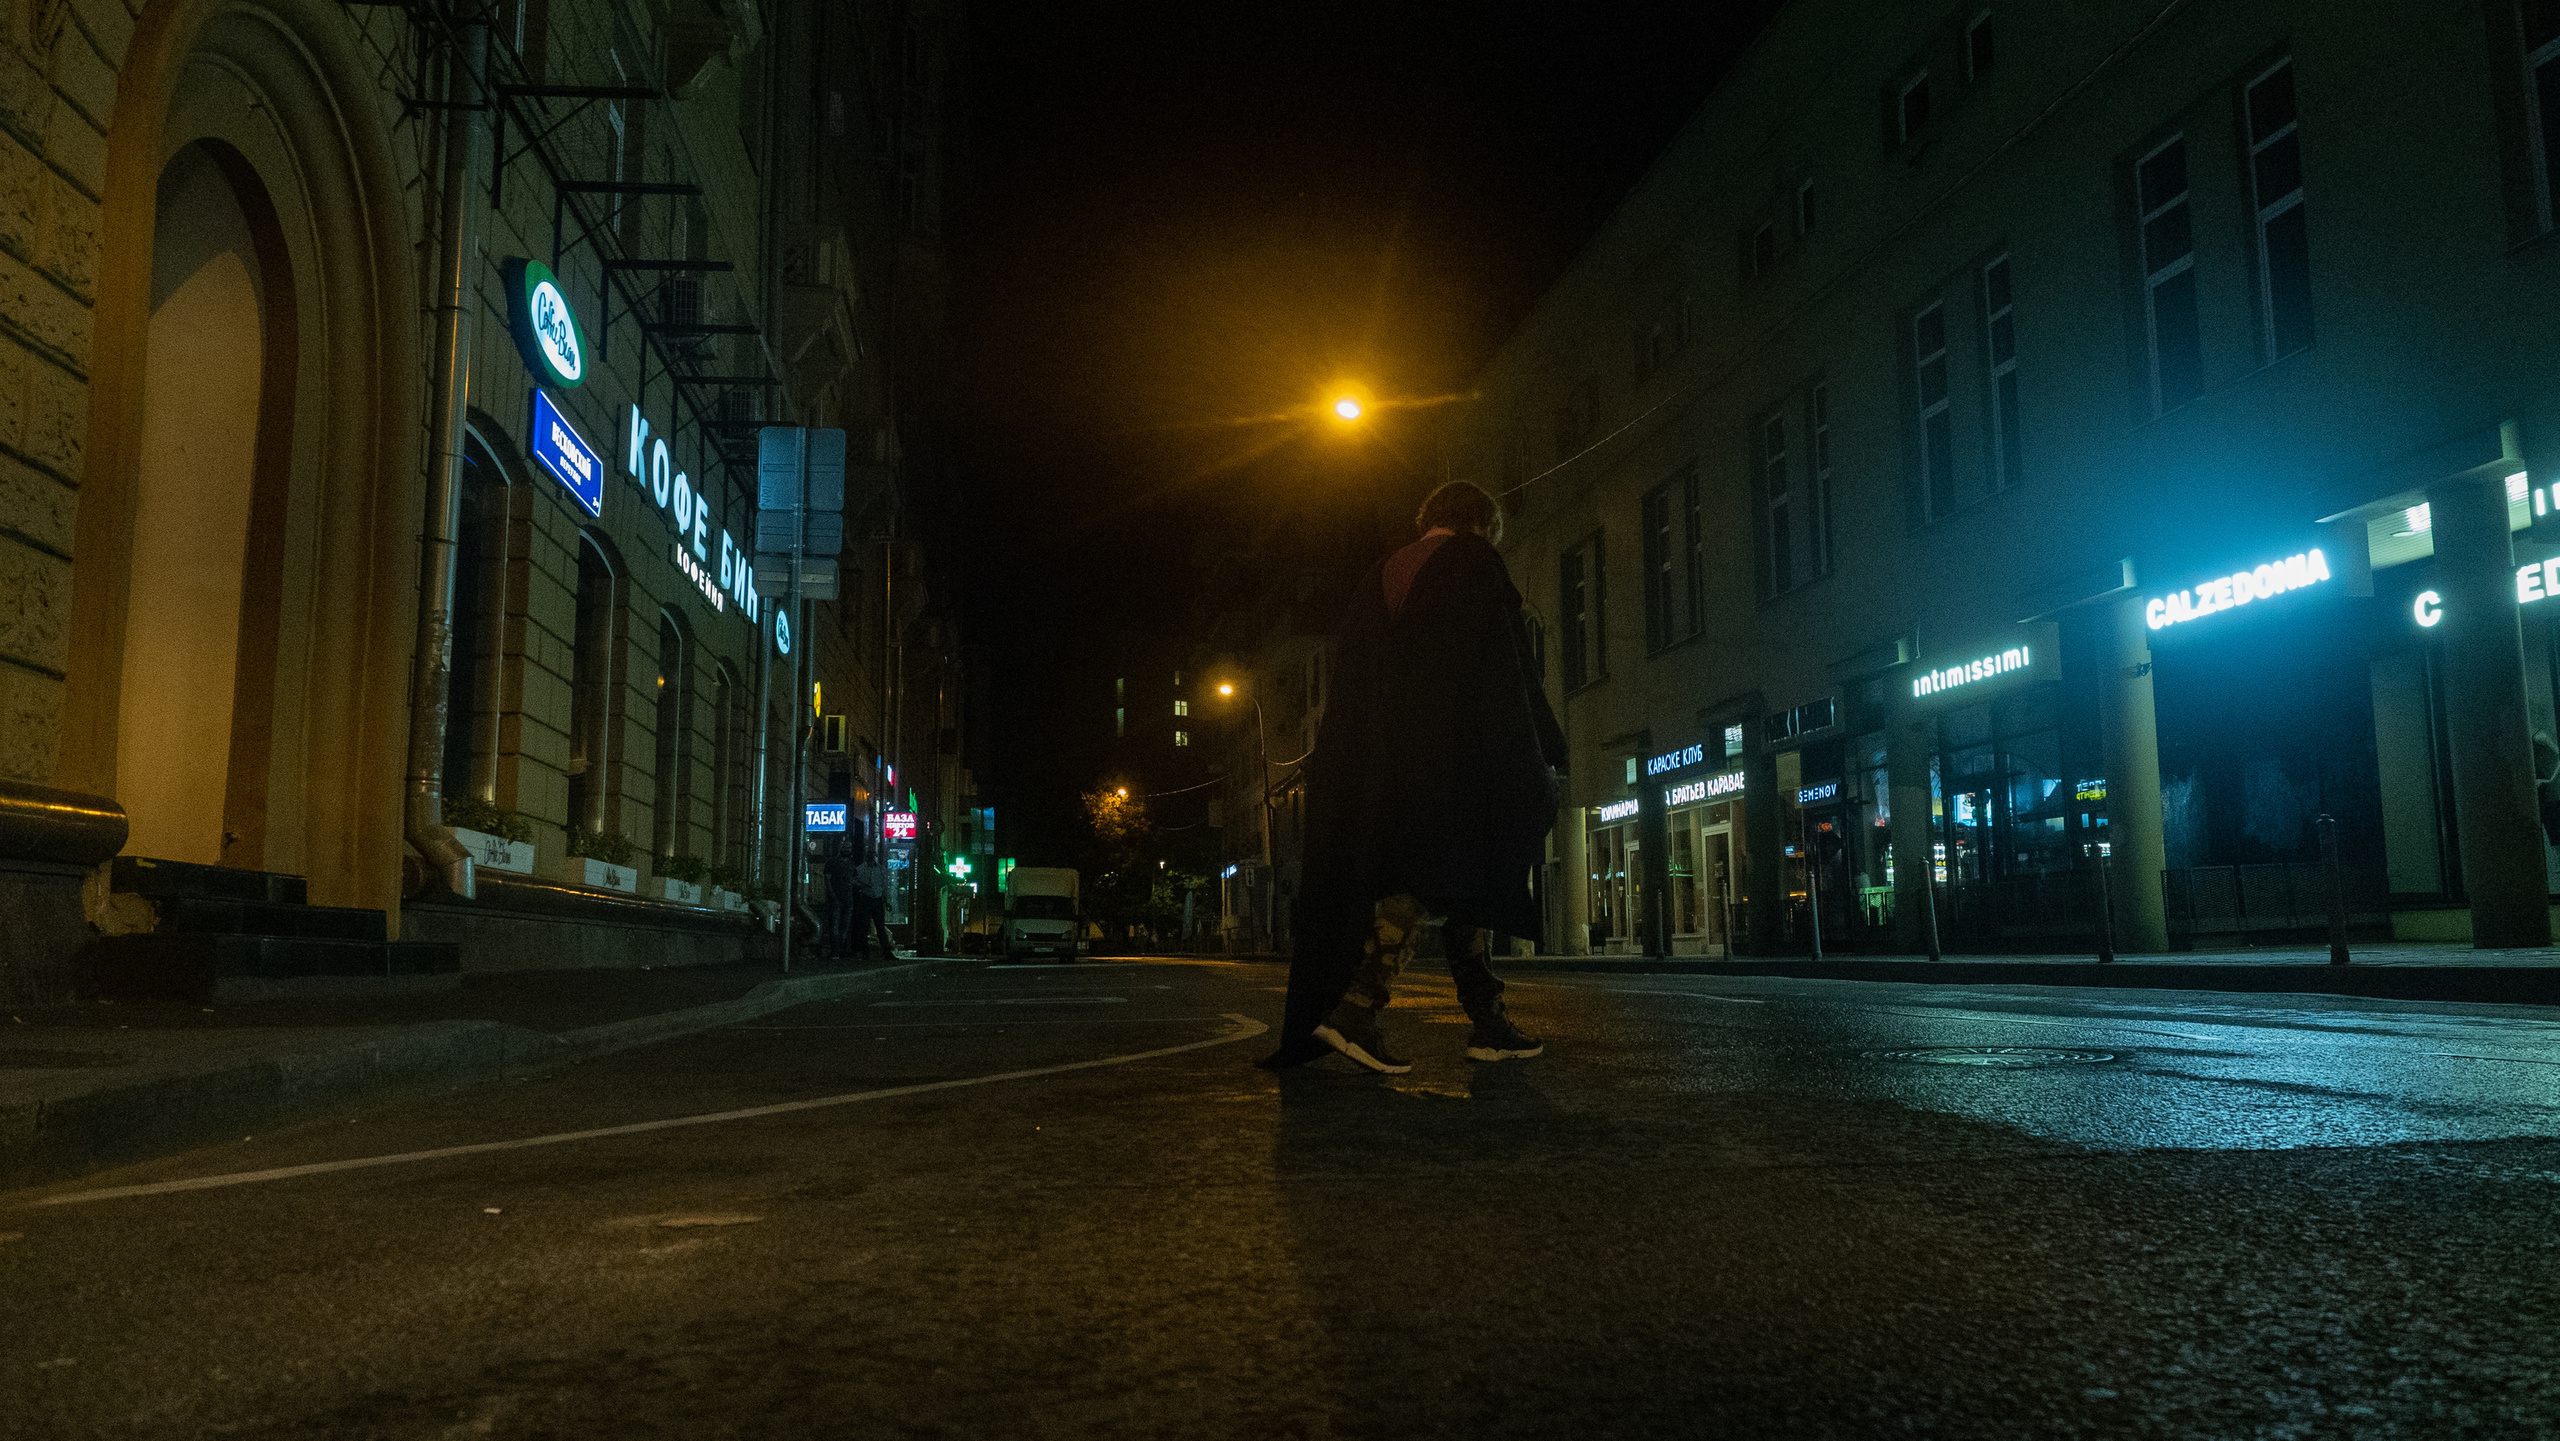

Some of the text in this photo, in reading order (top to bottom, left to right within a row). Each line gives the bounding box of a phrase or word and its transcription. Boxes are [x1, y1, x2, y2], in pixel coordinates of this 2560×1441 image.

[628, 403, 709, 562] КОФЕ
[677, 543, 723, 613] КОФЕЙНЯ
[2146, 548, 2330, 629] CALZEDONIA
[1913, 645, 2030, 698] intimissimi
[1647, 744, 1703, 776] КАРАОКЕ КЛУБ
[1672, 781, 1706, 806] БРАТЬЕВ
[1798, 783, 1837, 803] SEMENOV
[806, 810, 845, 825] ТАБАК
[886, 814, 914, 822] БАЗА
[892, 828, 908, 837] 24
